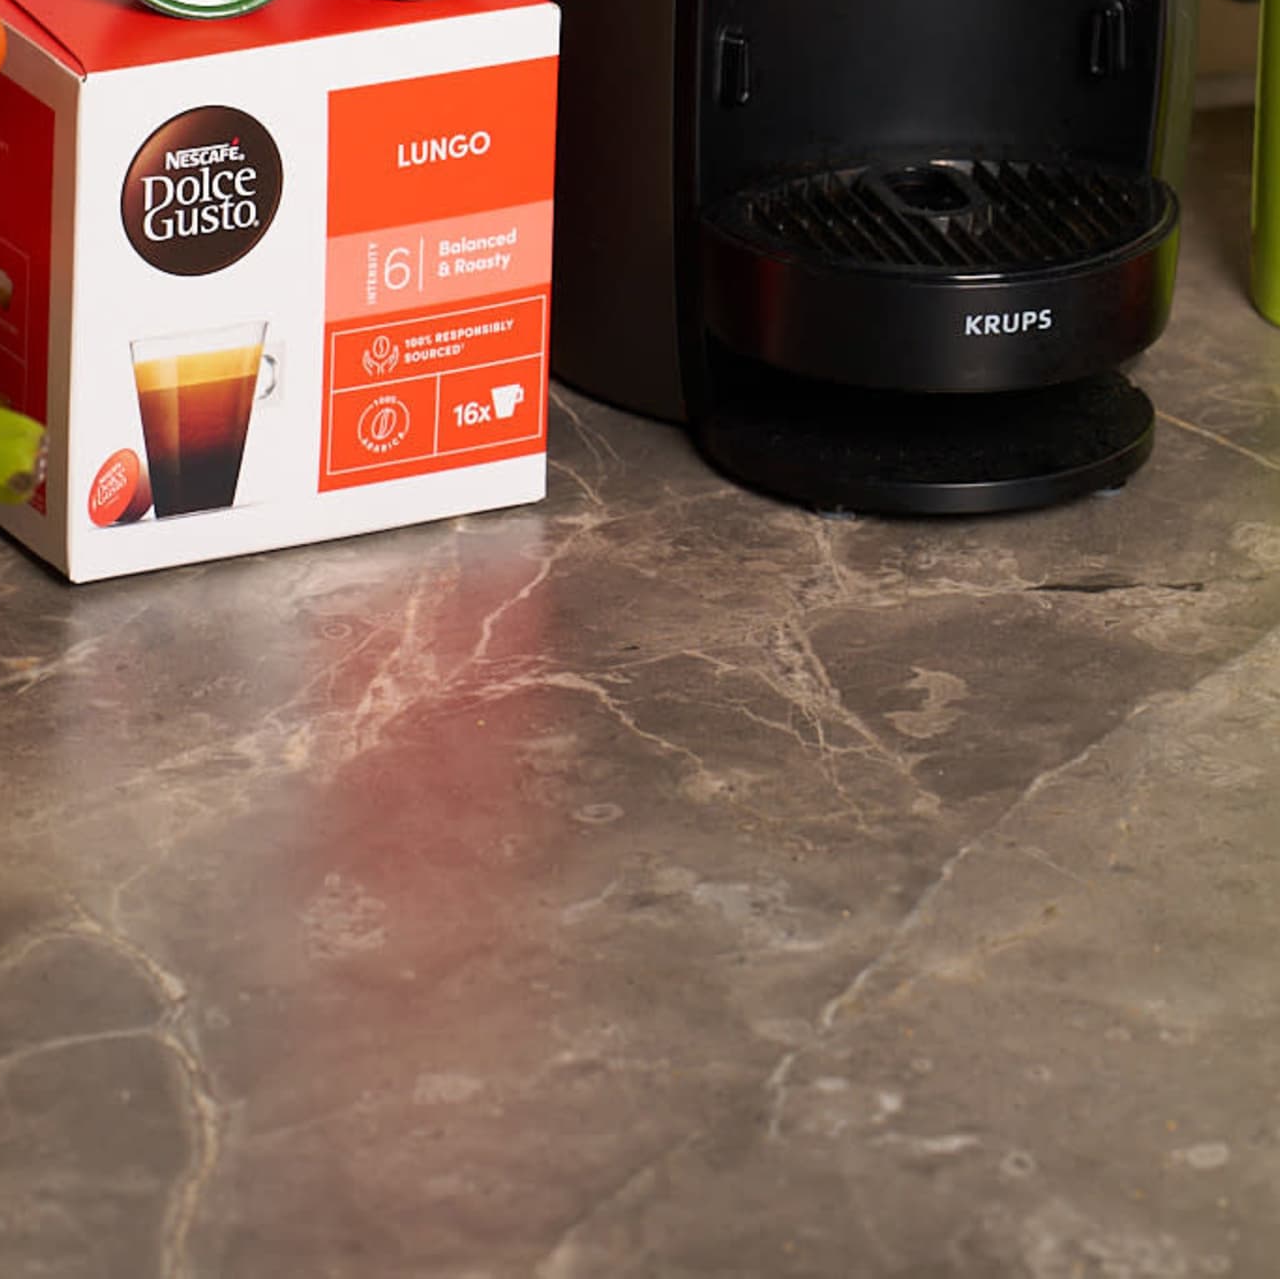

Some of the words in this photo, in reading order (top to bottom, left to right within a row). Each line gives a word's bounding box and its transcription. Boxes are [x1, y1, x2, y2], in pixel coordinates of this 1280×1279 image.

[165, 136, 241, 170] NESCAFÉ
[397, 130, 491, 169] LUNGO
[140, 166, 257, 212] Dolce
[143, 195, 259, 242] Gusto
[438, 227, 518, 257] Balanced
[384, 247, 411, 290] 6
[437, 261, 451, 278] &
[454, 253, 511, 275] Roasty
[434, 318, 514, 343] RESPONSIBLY
[964, 309, 1053, 336] KRUPS
[453, 402, 493, 428] 16x
